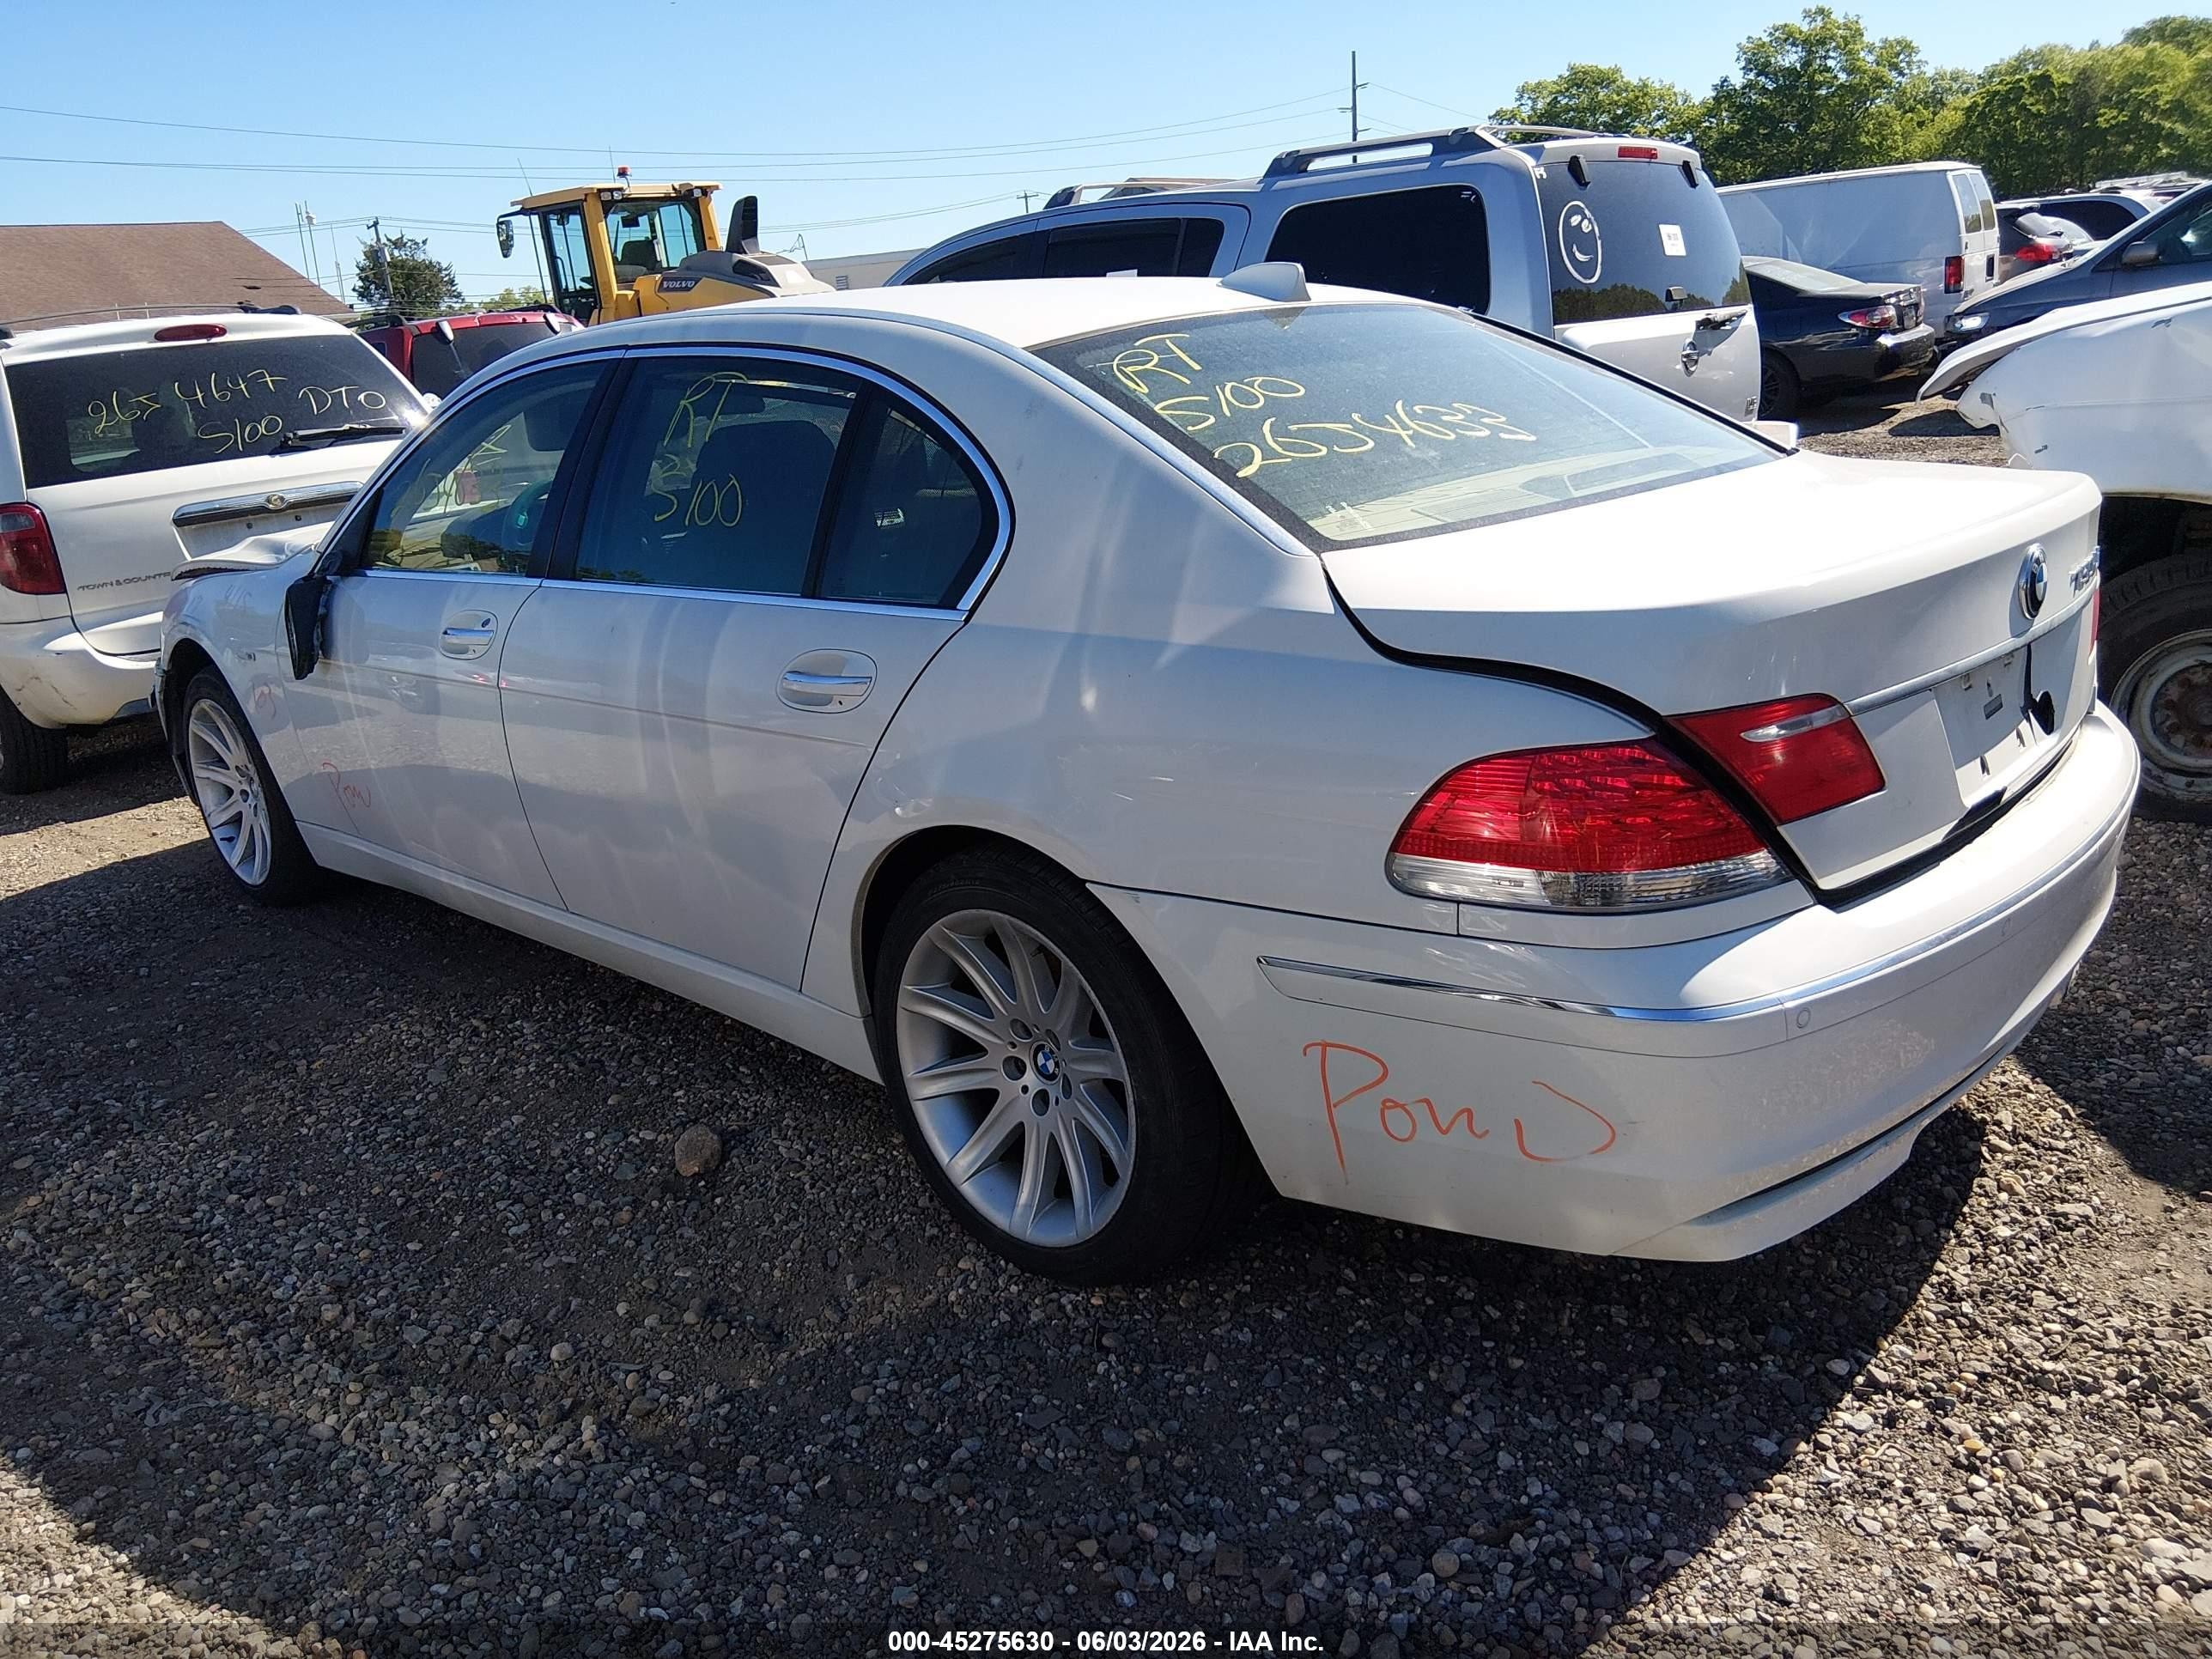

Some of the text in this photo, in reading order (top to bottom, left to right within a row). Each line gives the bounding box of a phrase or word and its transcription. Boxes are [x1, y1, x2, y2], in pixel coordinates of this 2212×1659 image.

[663, 280, 696, 289] VOLVO
[1113, 332, 1202, 394] RT
[174, 368, 289, 410] 4647
[663, 371, 749, 448] RT
[76, 580, 113, 591] TOWN
